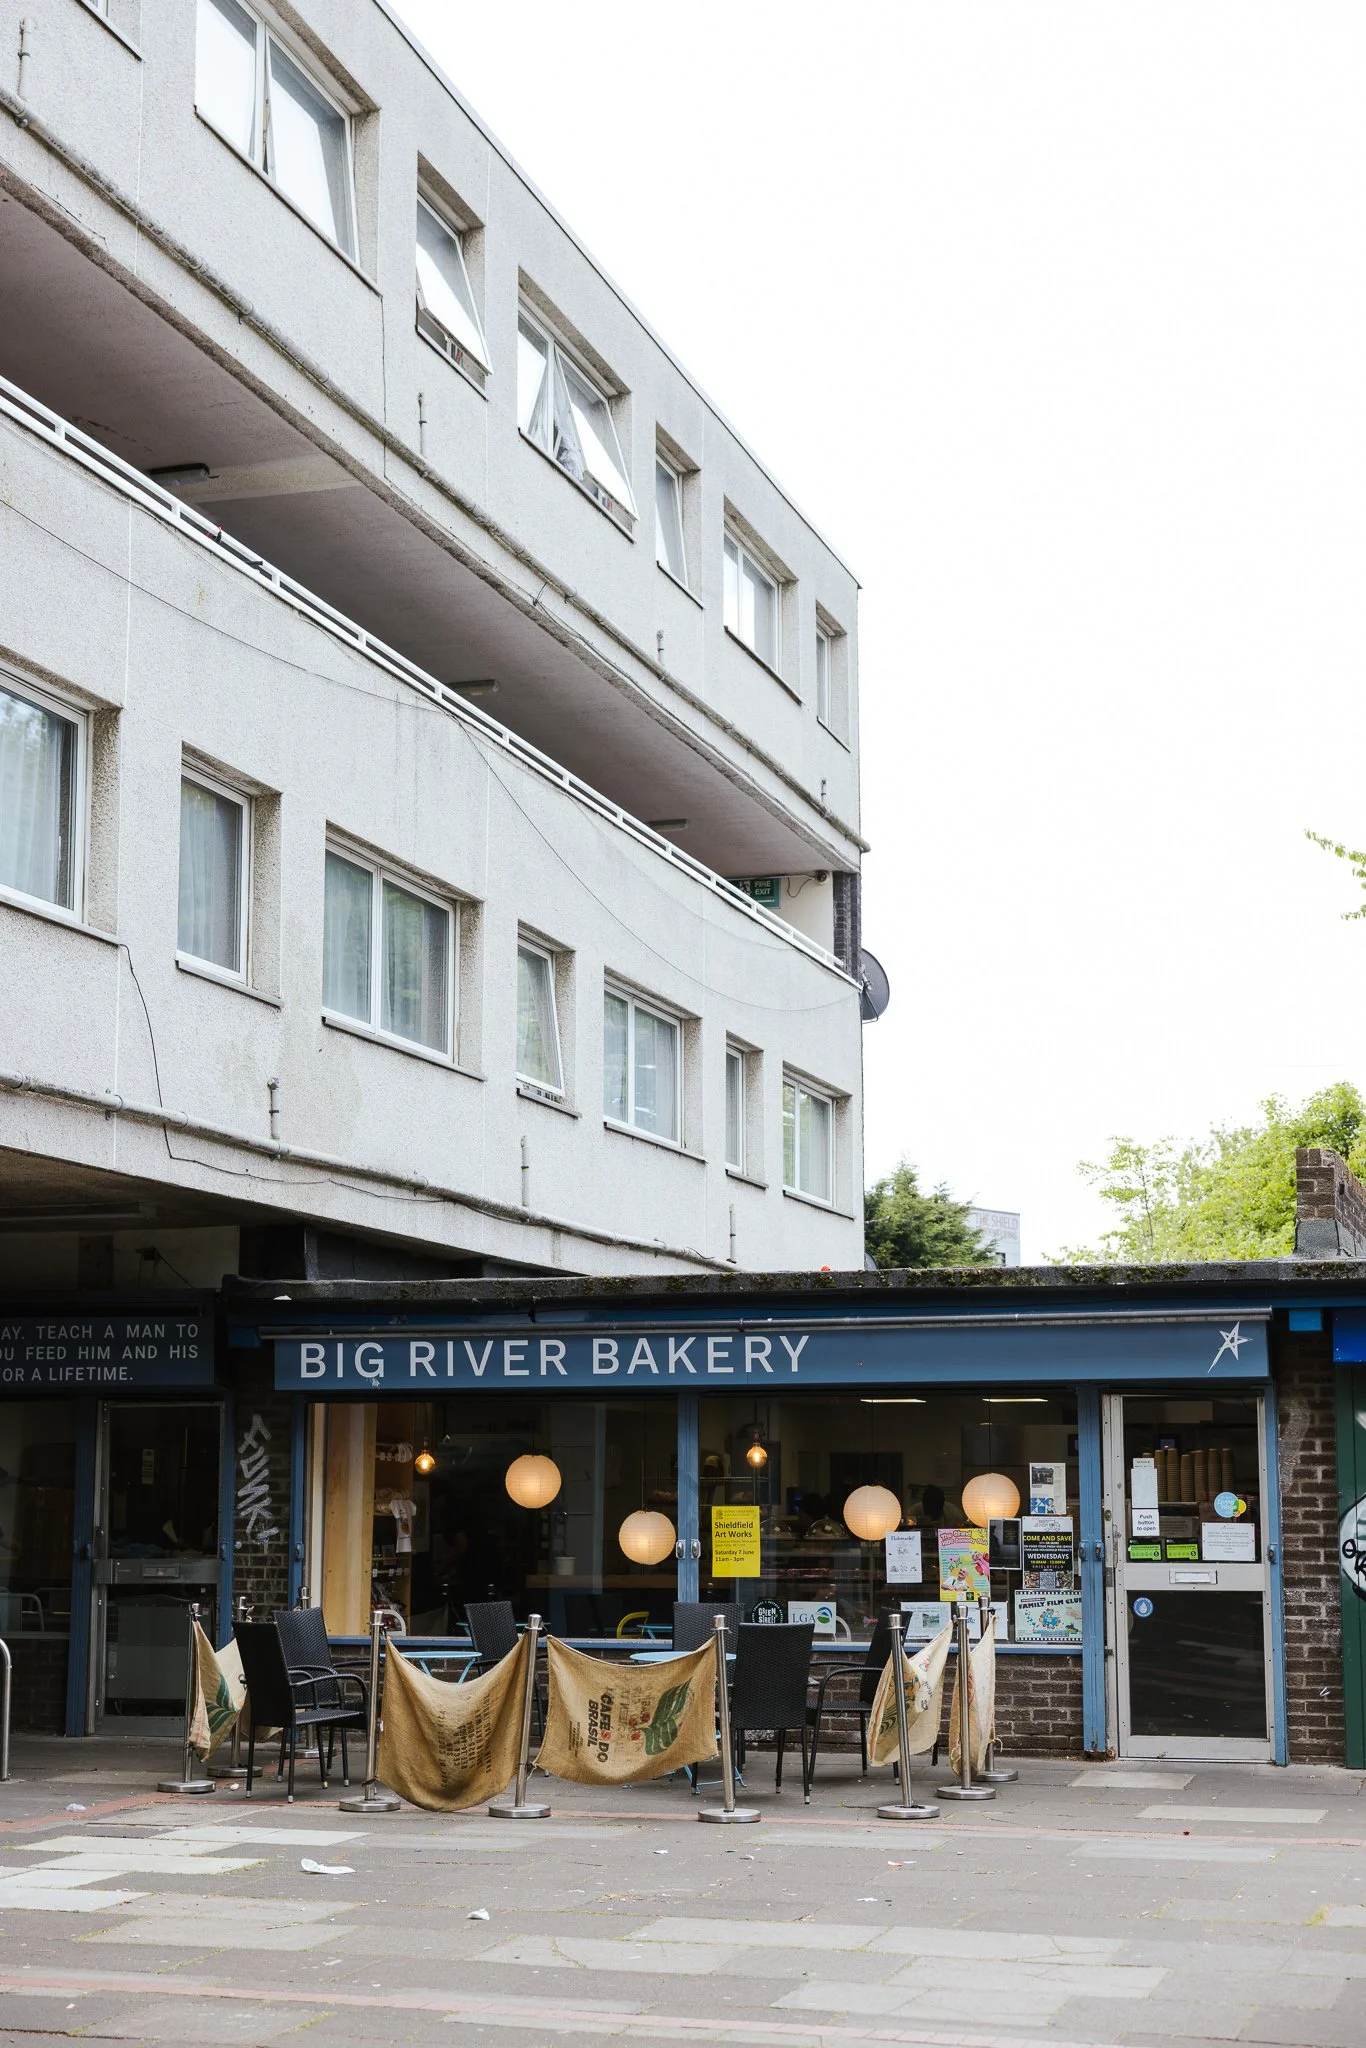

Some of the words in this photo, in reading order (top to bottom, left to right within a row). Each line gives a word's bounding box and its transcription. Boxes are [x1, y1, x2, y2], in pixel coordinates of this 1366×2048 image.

[754, 888, 772, 896] EXIT
[36, 1325, 93, 1339] TEACH
[104, 1325, 115, 1338] A
[126, 1324, 165, 1338] MAN
[176, 1323, 199, 1338] TO
[0, 1347, 15, 1361] U
[26, 1346, 67, 1360] FEED
[78, 1346, 111, 1360] HIM
[122, 1345, 158, 1359] AND
[169, 1344, 199, 1359] HIS
[300, 1341, 385, 1378] BIG
[409, 1339, 568, 1377] RIVER
[592, 1335, 810, 1375] BAKERY
[0, 1367, 24, 1382] OR
[31, 1367, 42, 1381] A
[49, 1366, 133, 1381] LIFETIME.
[714, 1521, 754, 1529] Shieldfield
[727, 1530, 753, 1538] Works
[758, 1607, 776, 1616] GREEN
[792, 1613, 816, 1623] LGA
[758, 1615, 776, 1623] STREET
[587, 1698, 599, 1748] BRASIL
[597, 1741, 610, 1763] DO
